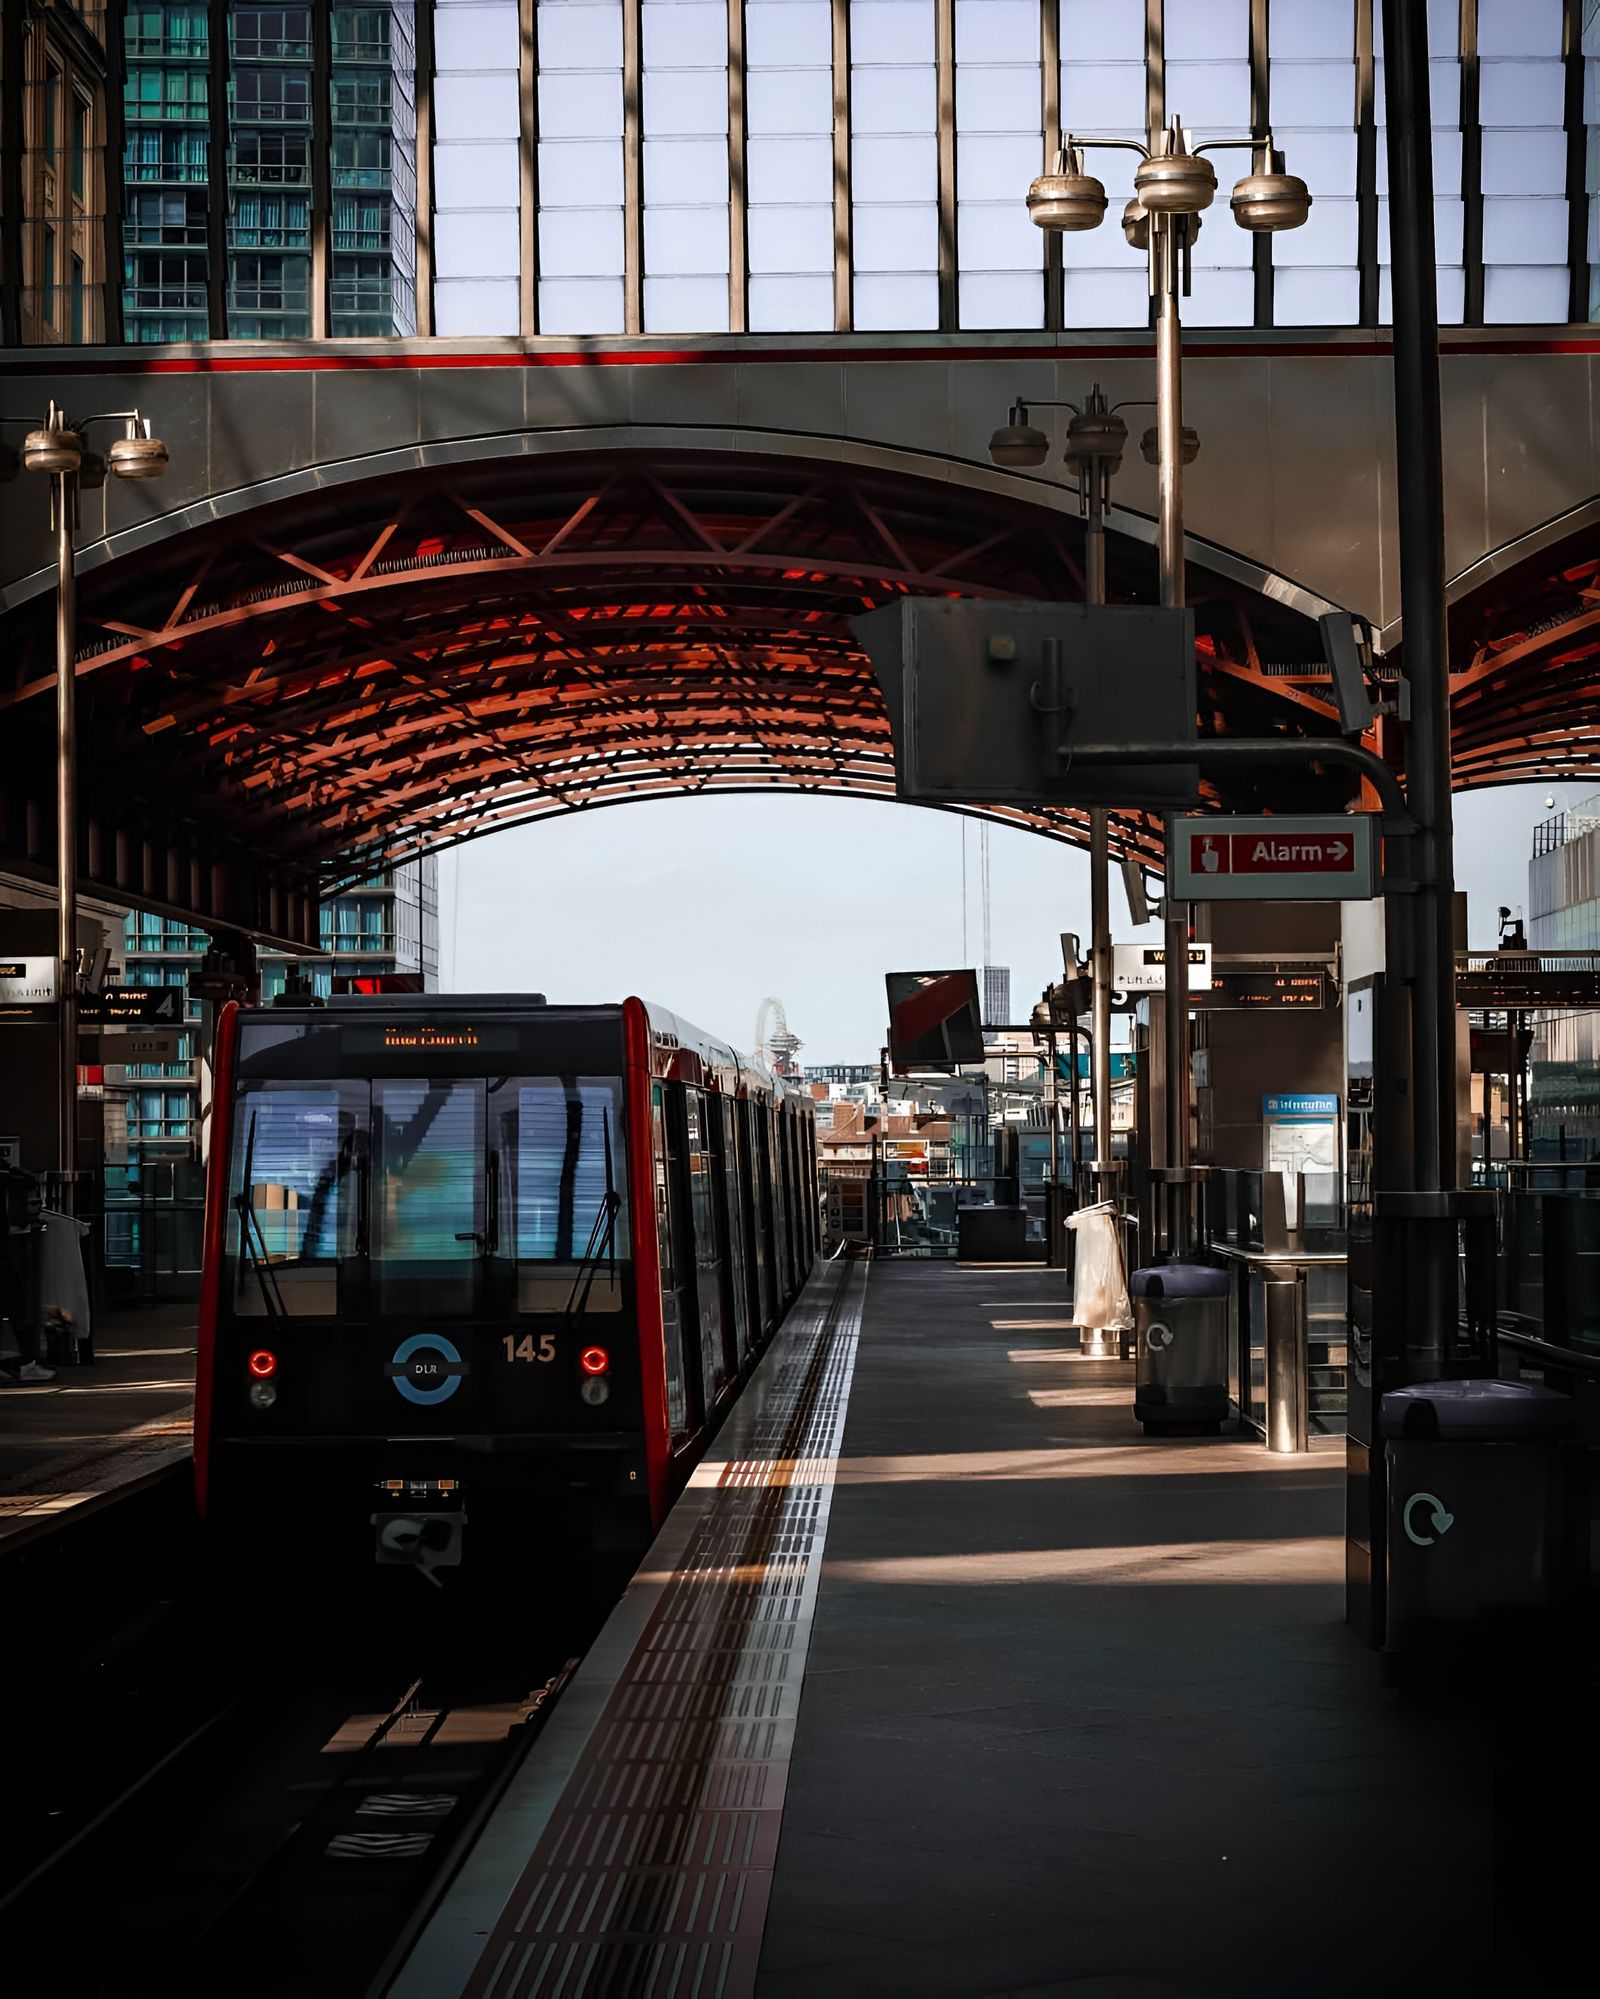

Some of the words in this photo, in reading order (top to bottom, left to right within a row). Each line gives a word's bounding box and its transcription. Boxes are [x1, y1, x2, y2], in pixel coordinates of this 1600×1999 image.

[1252, 841, 1322, 861] Alarm
[156, 993, 174, 1017] 4
[503, 1334, 555, 1362] 145
[415, 1364, 438, 1374] DLR
